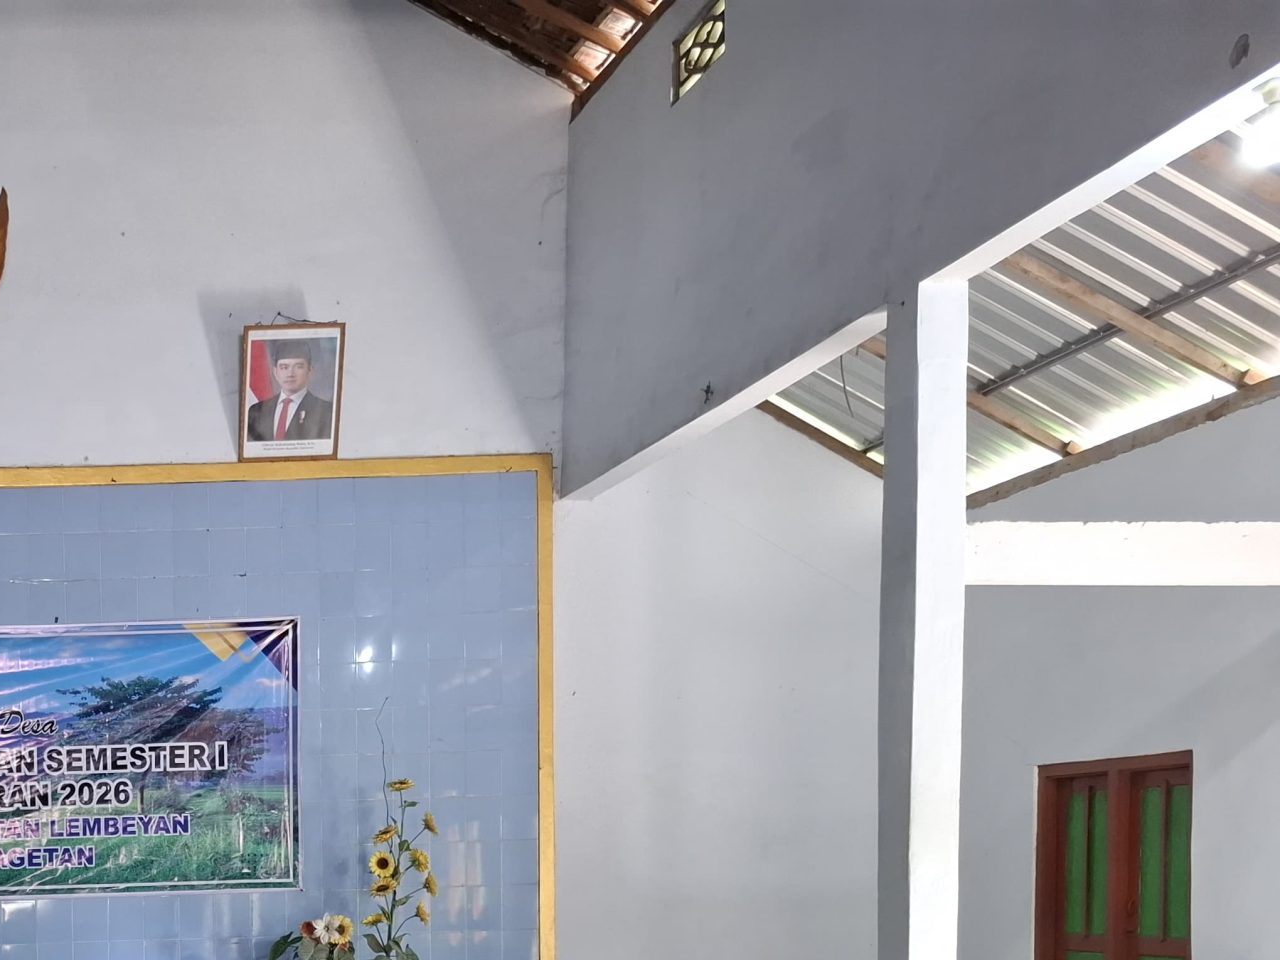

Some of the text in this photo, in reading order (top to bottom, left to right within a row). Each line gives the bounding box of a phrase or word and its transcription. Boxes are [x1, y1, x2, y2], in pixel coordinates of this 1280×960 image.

[0, 710, 58, 737] Desa
[44, 742, 212, 775] SEMESTER
[216, 741, 228, 771] I
[58, 778, 133, 807] 2026
[49, 814, 191, 839] LEMBEYAN
